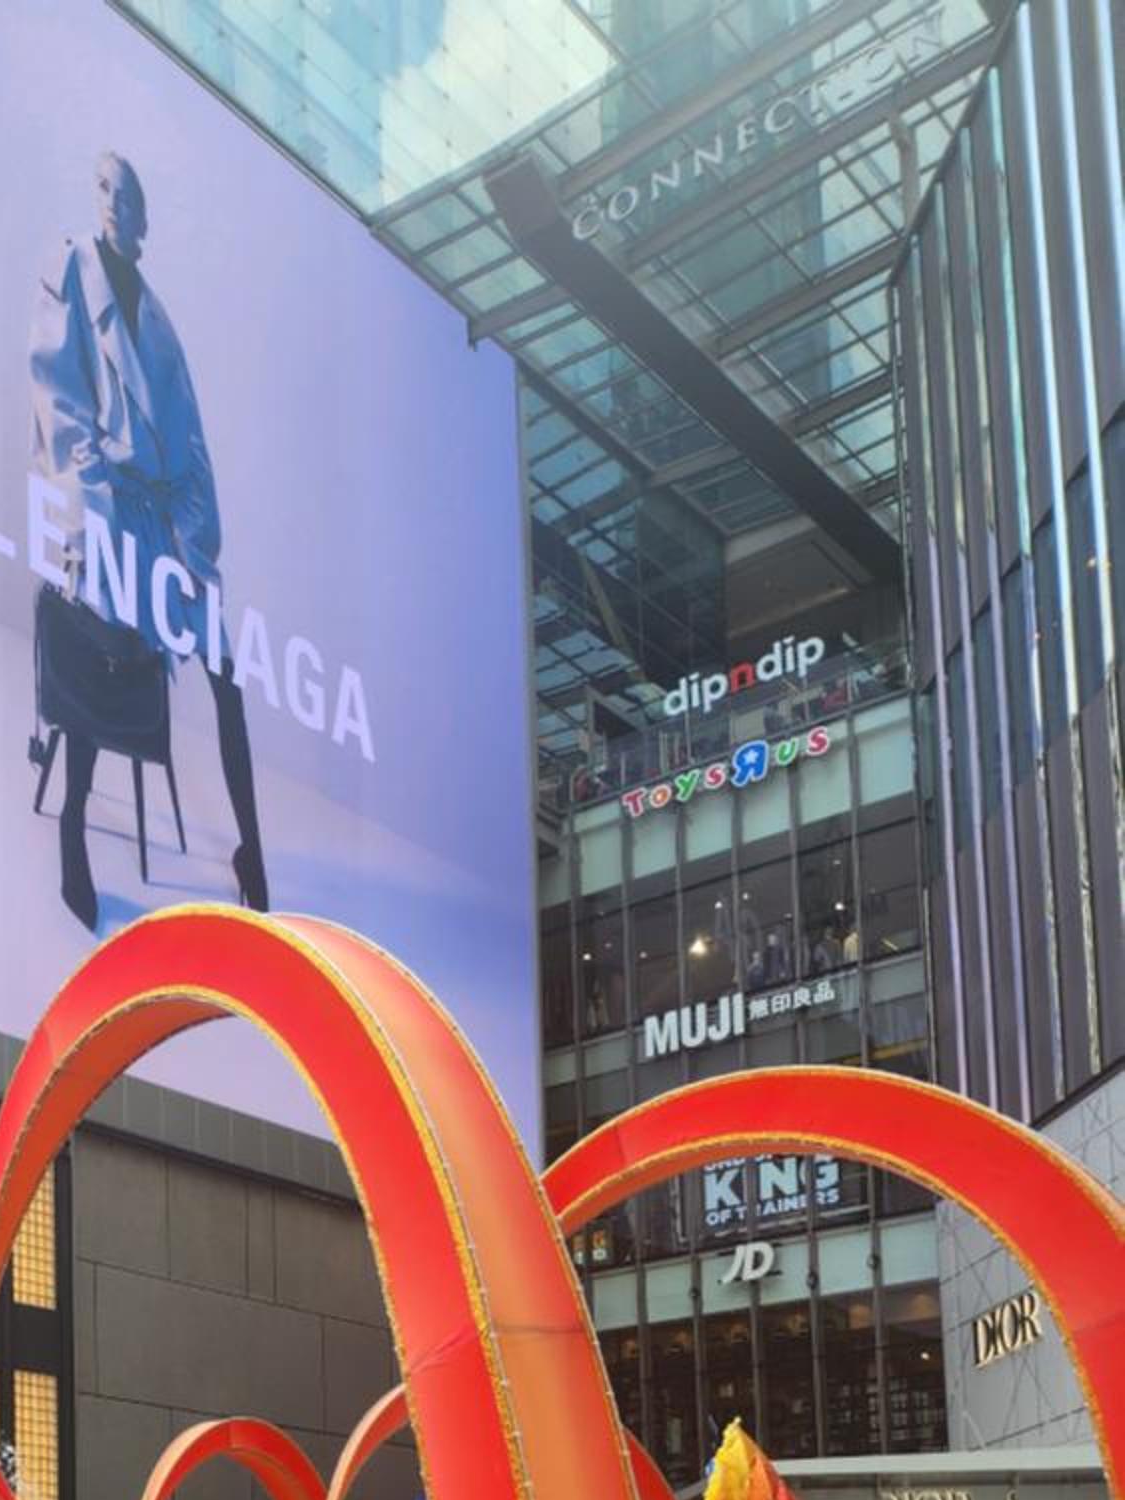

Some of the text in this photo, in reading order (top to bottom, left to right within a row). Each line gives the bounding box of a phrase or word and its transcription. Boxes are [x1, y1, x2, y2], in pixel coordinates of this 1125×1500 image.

[663, 635, 825, 716] dipndip
[643, 991, 746, 1058] MUJI
[704, 1209, 732, 1226] OF
[722, 1240, 775, 1285] JD
[973, 1291, 1043, 1369] DIOR
